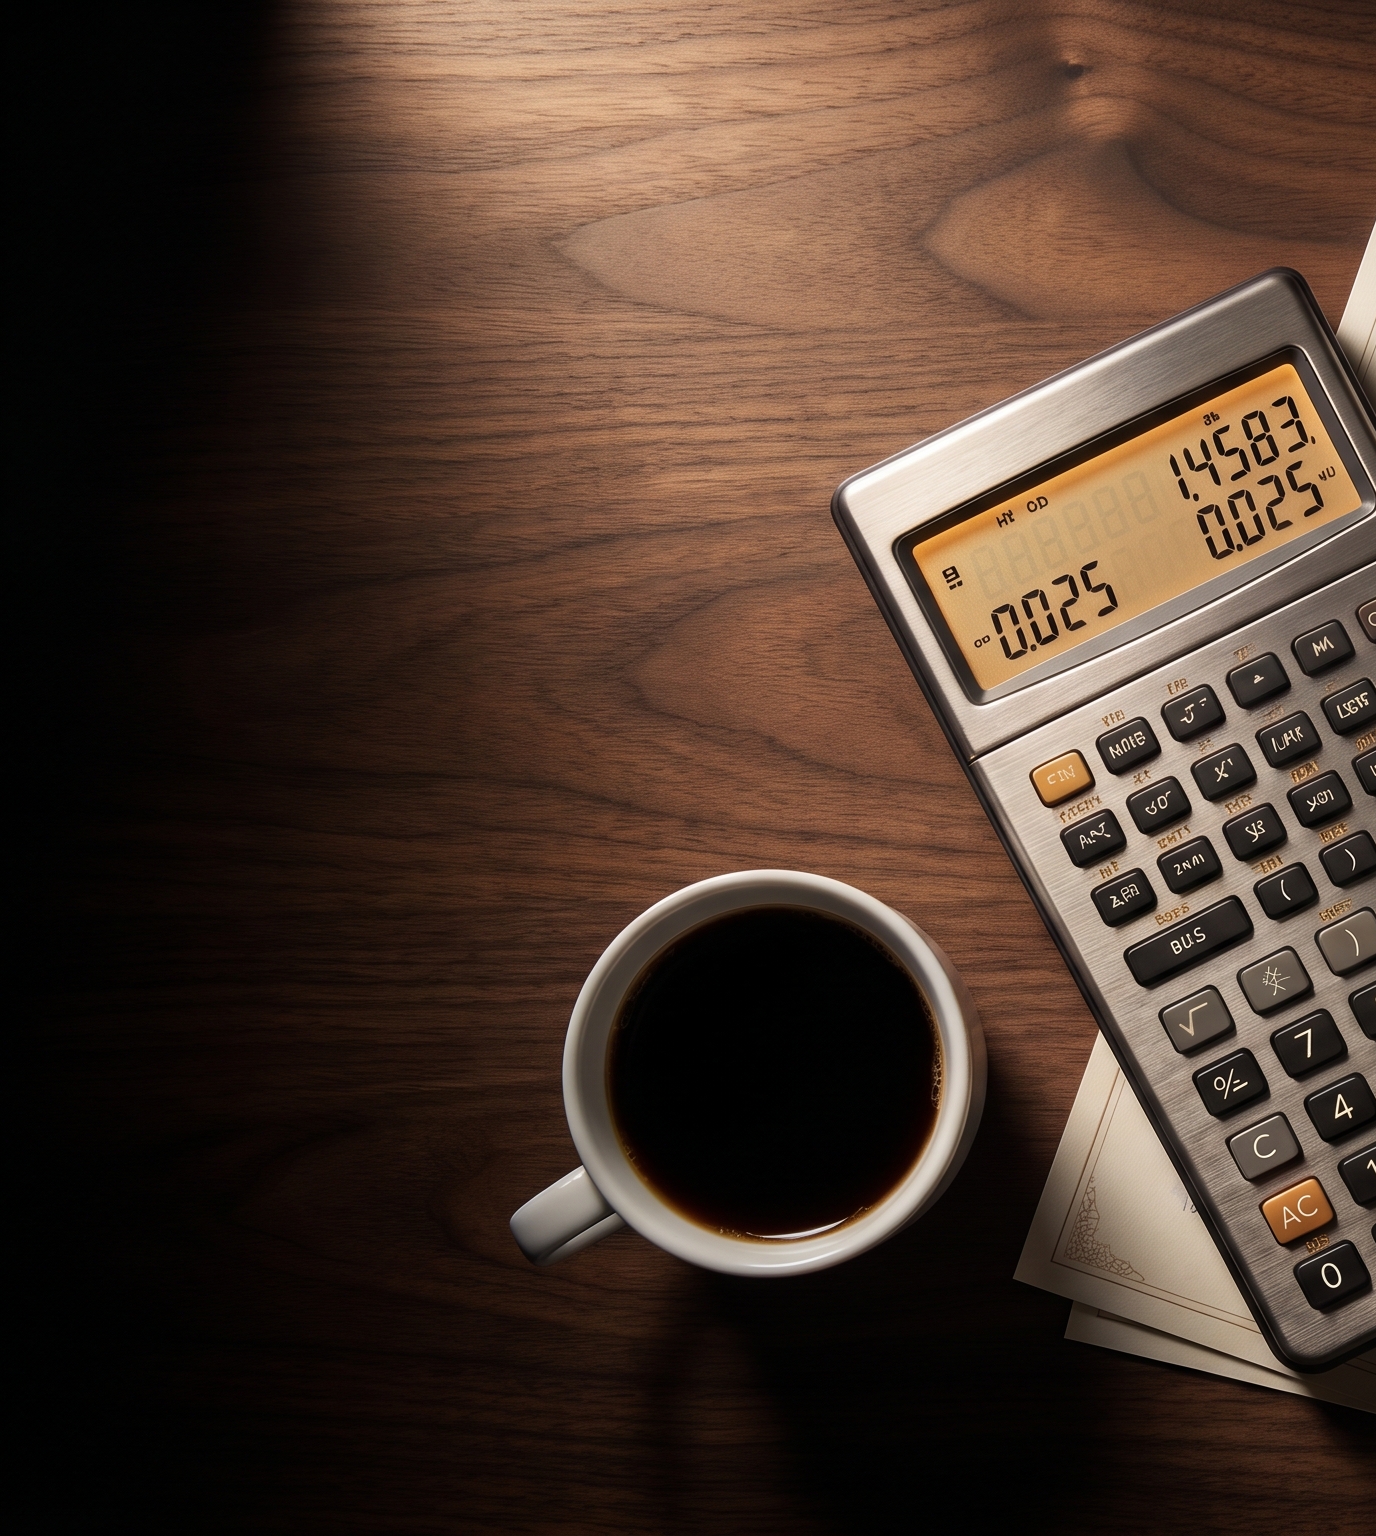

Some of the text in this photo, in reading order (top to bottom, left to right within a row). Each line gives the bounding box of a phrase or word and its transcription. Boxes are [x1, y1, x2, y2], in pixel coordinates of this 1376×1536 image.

[1197, 461, 1324, 559] 0.025
[991, 561, 1118, 660] 0.025
[1294, 1028, 1311, 1058] 7
[1334, 1093, 1354, 1119] 4
[1253, 1134, 1276, 1159] C
[1282, 1195, 1318, 1230] AC
[1321, 1263, 1342, 1288] 0
